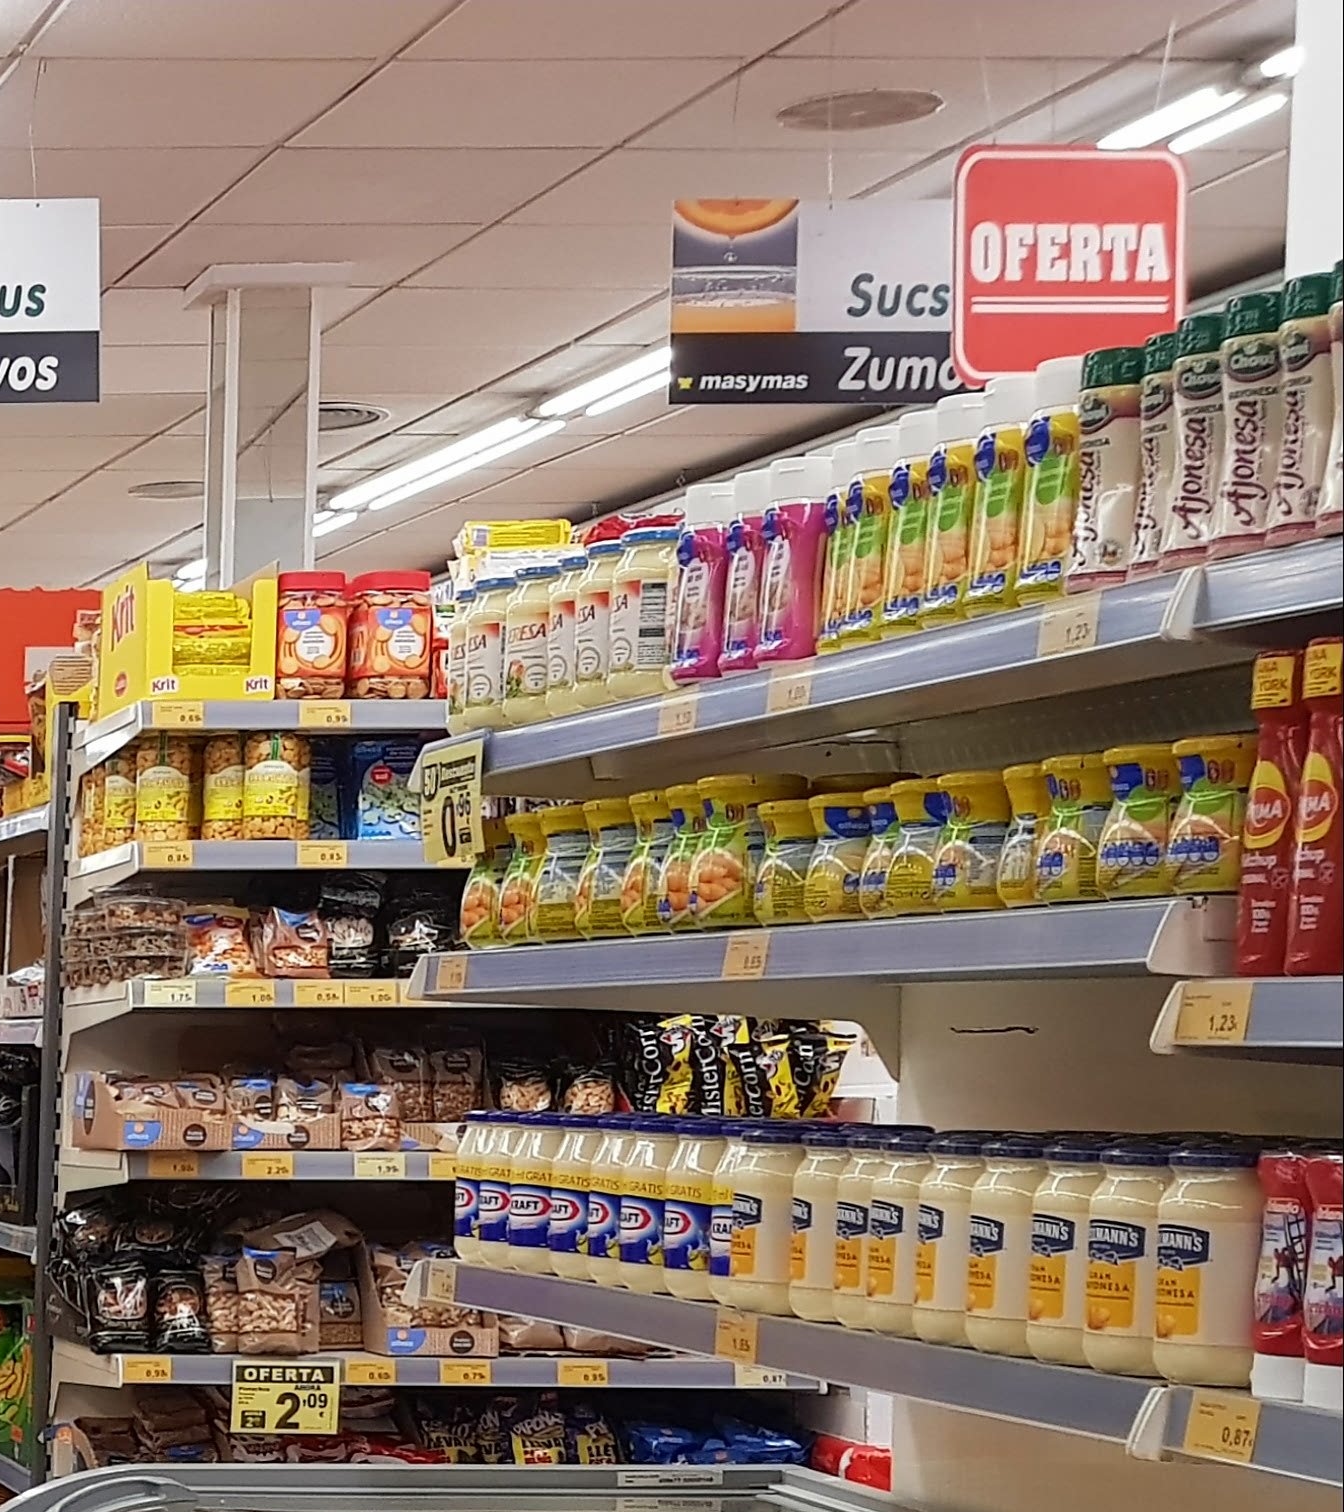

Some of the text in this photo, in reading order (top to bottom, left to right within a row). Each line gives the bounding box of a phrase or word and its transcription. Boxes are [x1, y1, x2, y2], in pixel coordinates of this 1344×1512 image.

[970, 222, 1170, 286] OFERTA
[847, 274, 950, 319] Sucs
[699, 370, 809, 392] masymas
[1172, 416, 1212, 540] Ajonesa
[1227, 399, 1269, 527] Ajonesa
[111, 583, 137, 651] Krit
[151, 677, 178, 694] Krit
[245, 675, 270, 693] Krit
[243, 1368, 325, 1382] OFERTA
